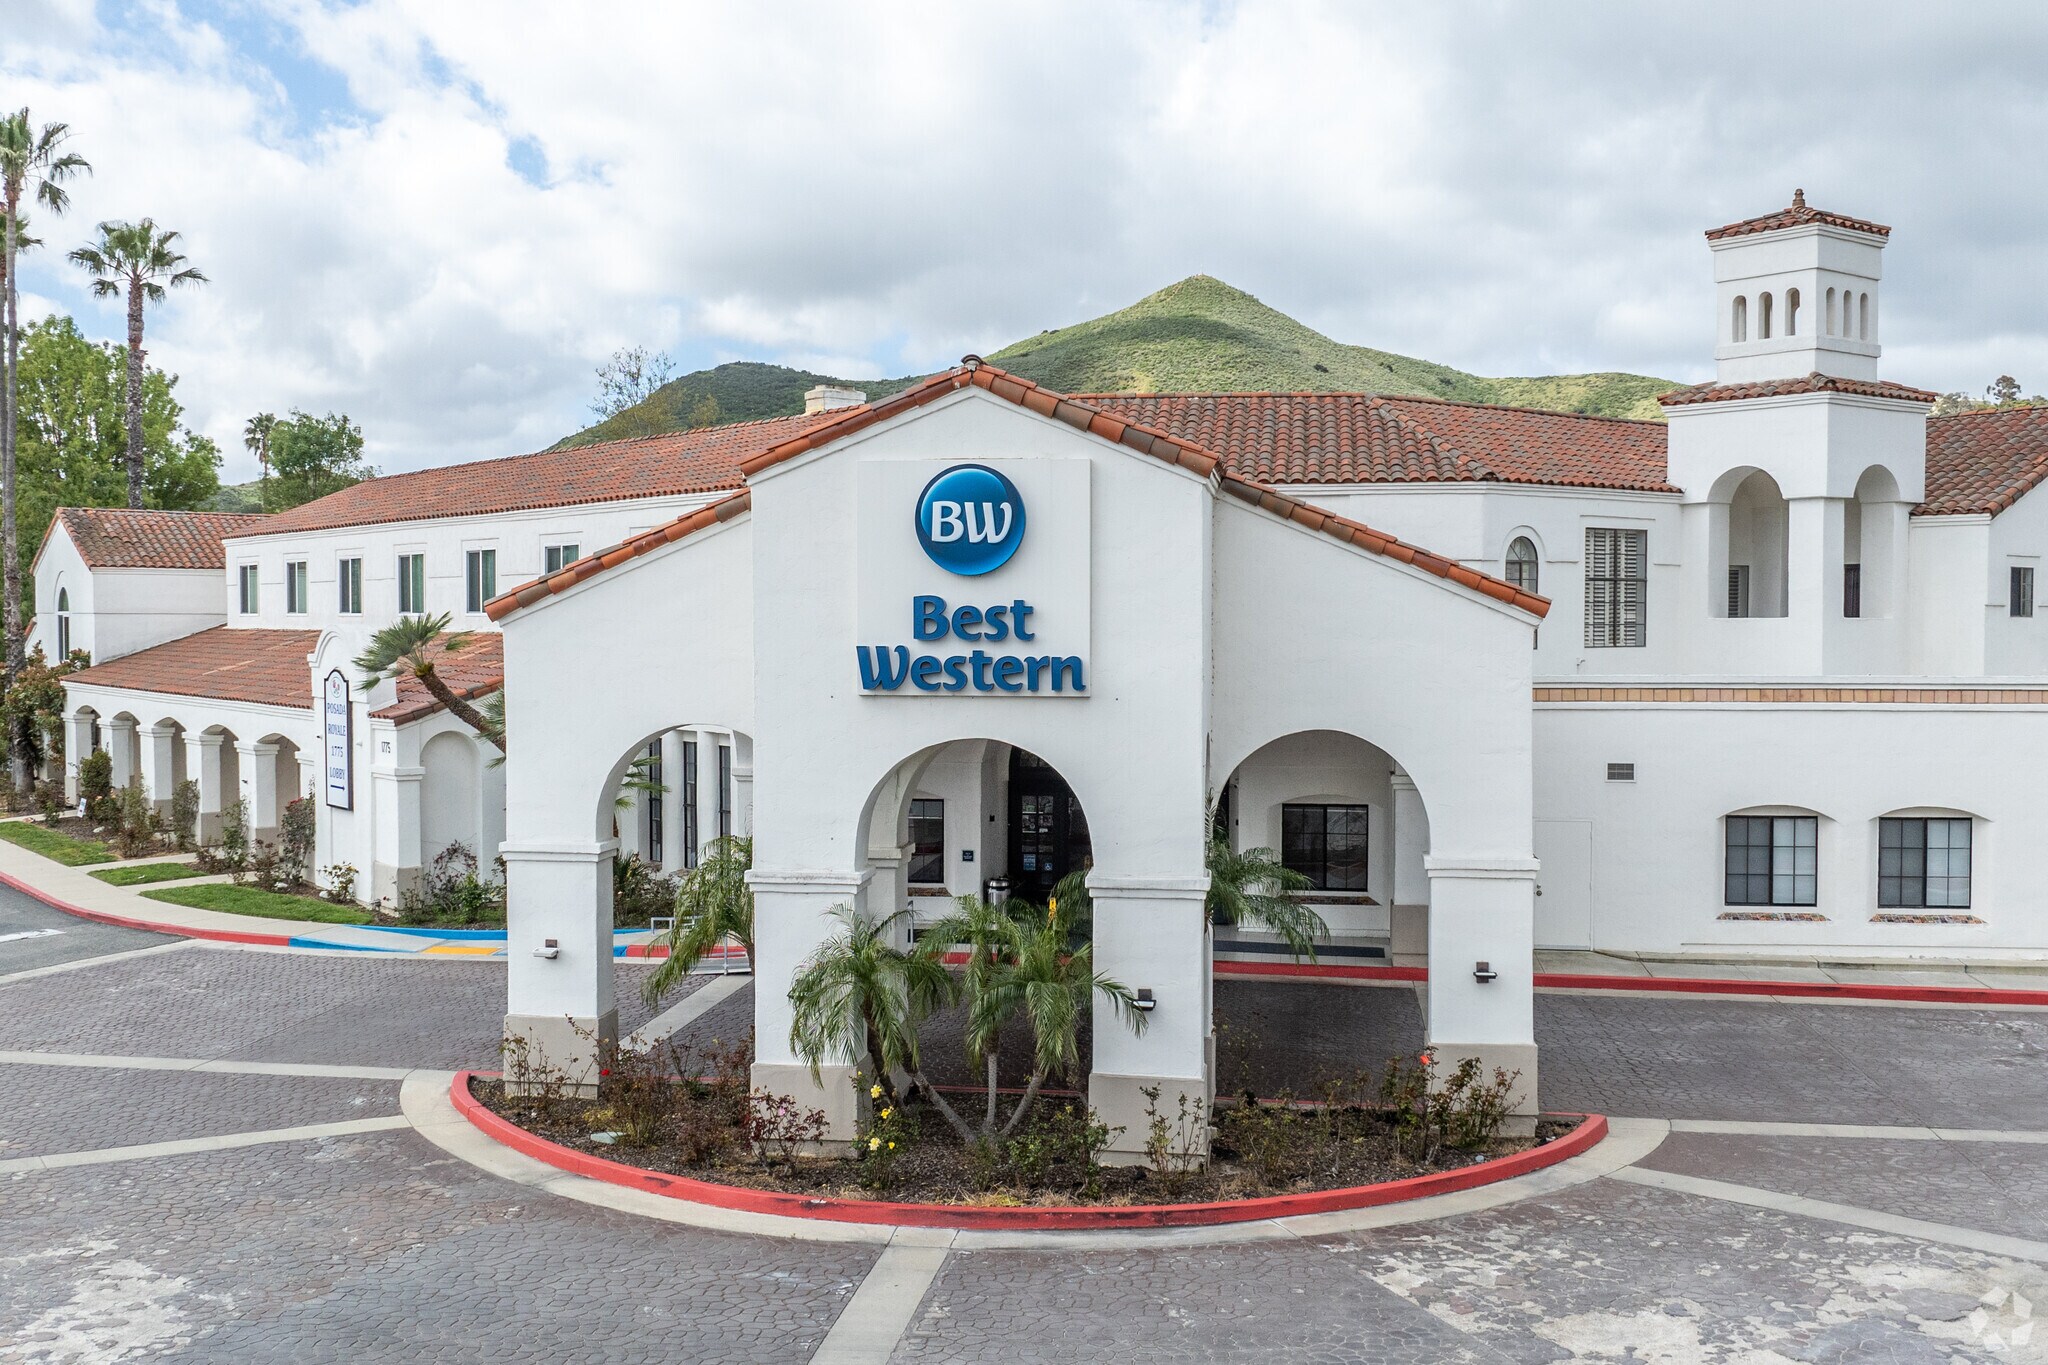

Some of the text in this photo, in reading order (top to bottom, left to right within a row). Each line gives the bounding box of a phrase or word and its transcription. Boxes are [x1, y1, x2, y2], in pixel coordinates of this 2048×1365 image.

[931, 500, 1012, 543] BW
[913, 595, 1035, 641] Best
[856, 645, 1086, 691] Western
[327, 702, 346, 715] POSADA
[328, 723, 346, 736] ROYALE
[331, 745, 344, 758] 1775
[329, 766, 345, 780] LOBBY
